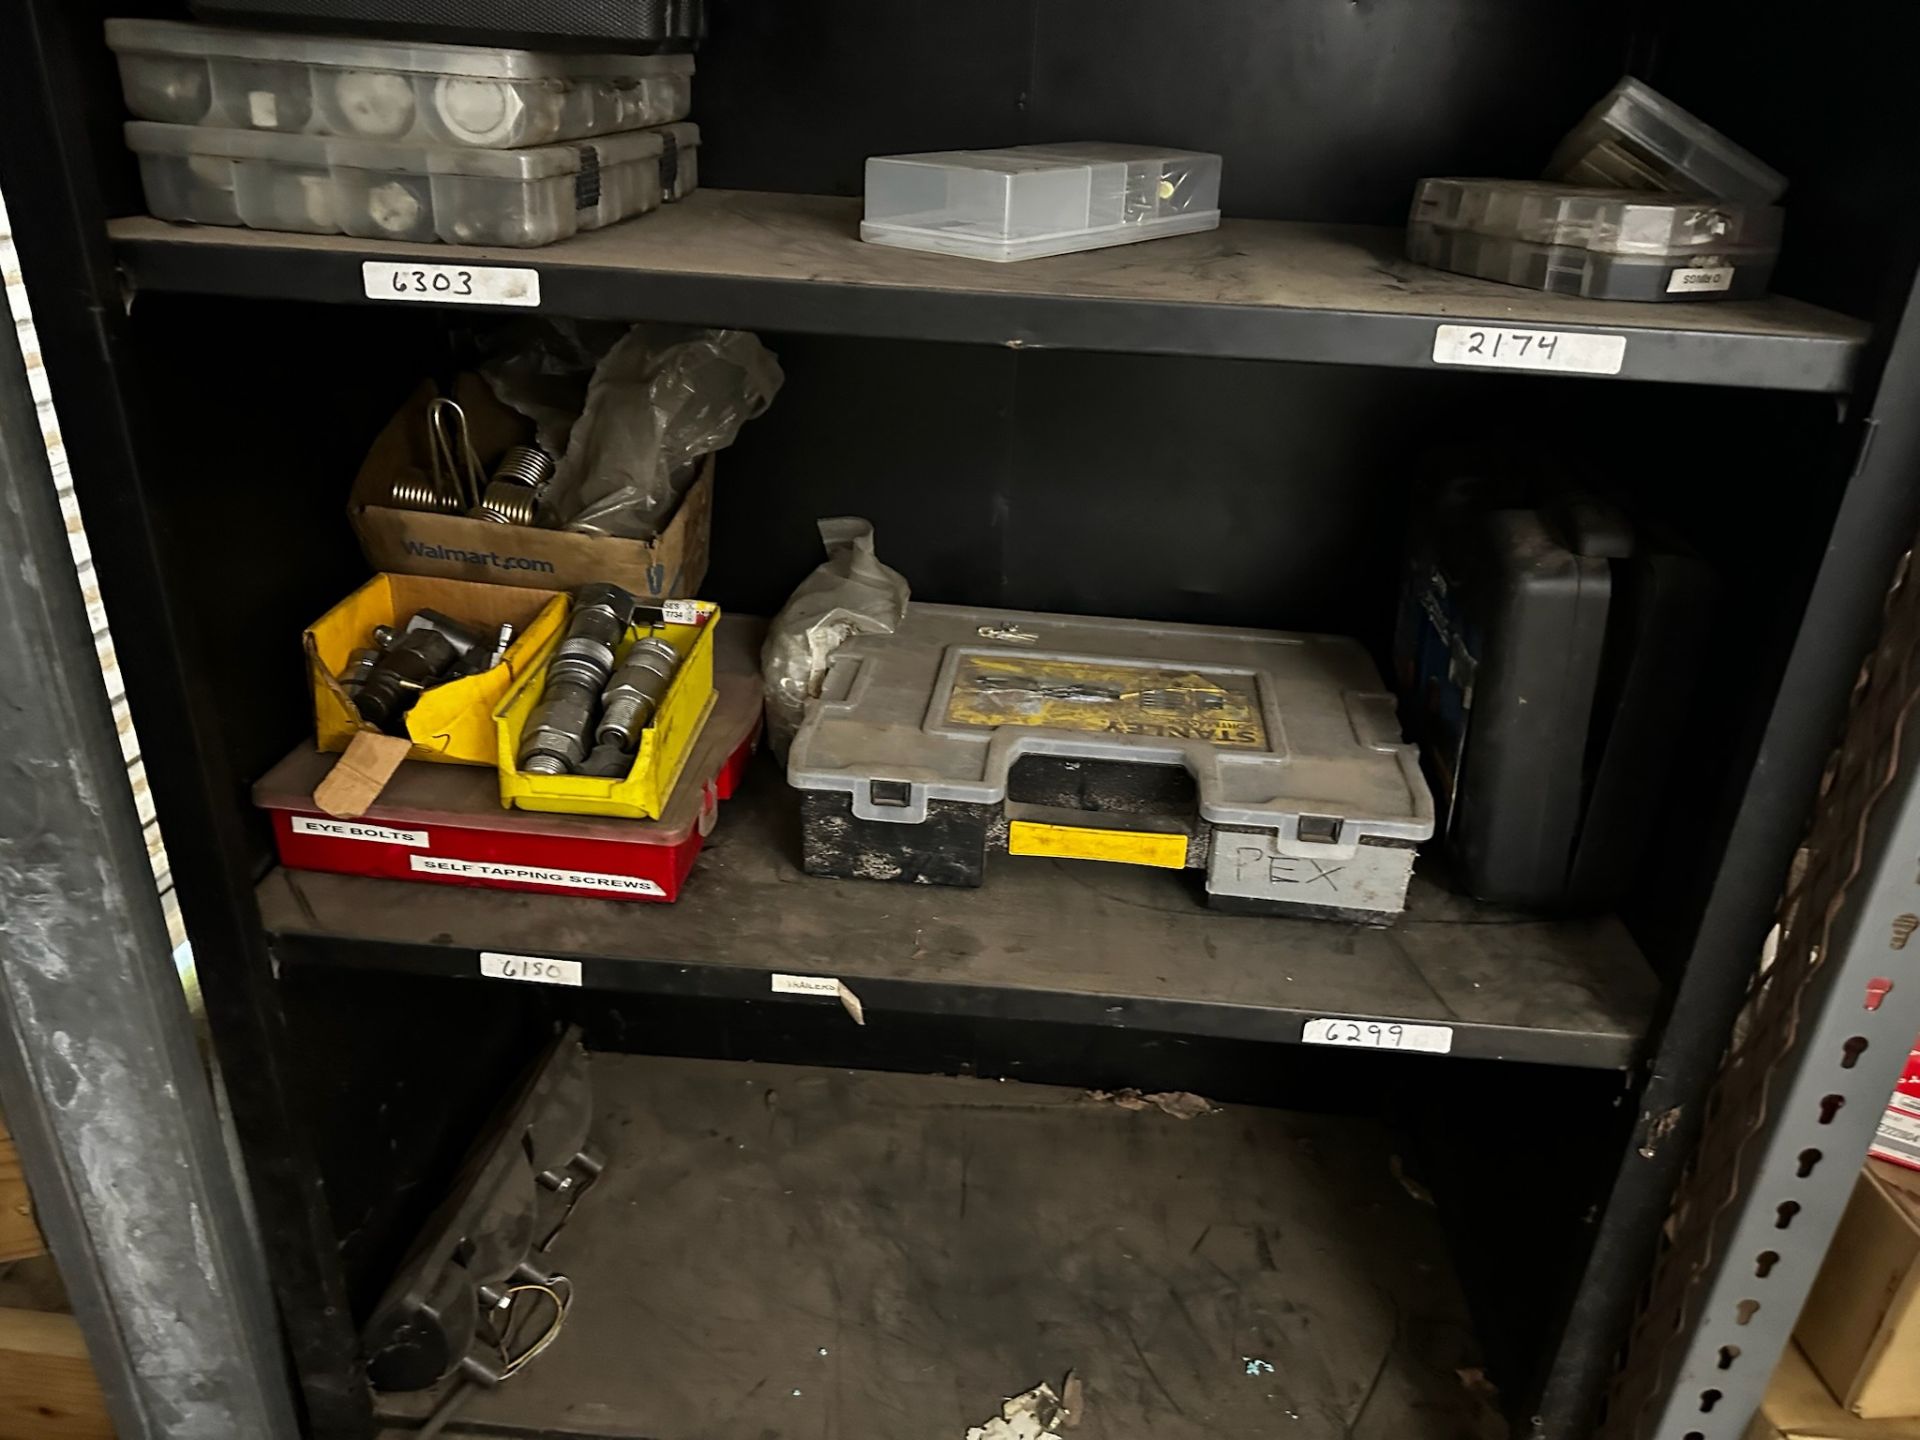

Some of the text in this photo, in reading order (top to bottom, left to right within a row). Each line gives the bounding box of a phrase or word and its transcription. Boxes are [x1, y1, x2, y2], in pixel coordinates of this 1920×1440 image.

[392, 271, 472, 295] 6303
[1468, 331, 1558, 360] 2174
[401, 541, 555, 574] Walmart.com
[1103, 719, 1257, 744] STANLEY
[306, 822, 415, 842] EYE BOLTS
[424, 860, 652, 891] SELF TAPPING SCREWS
[1236, 847, 1346, 892] PEX
[1325, 1023, 1403, 1047] 6299
